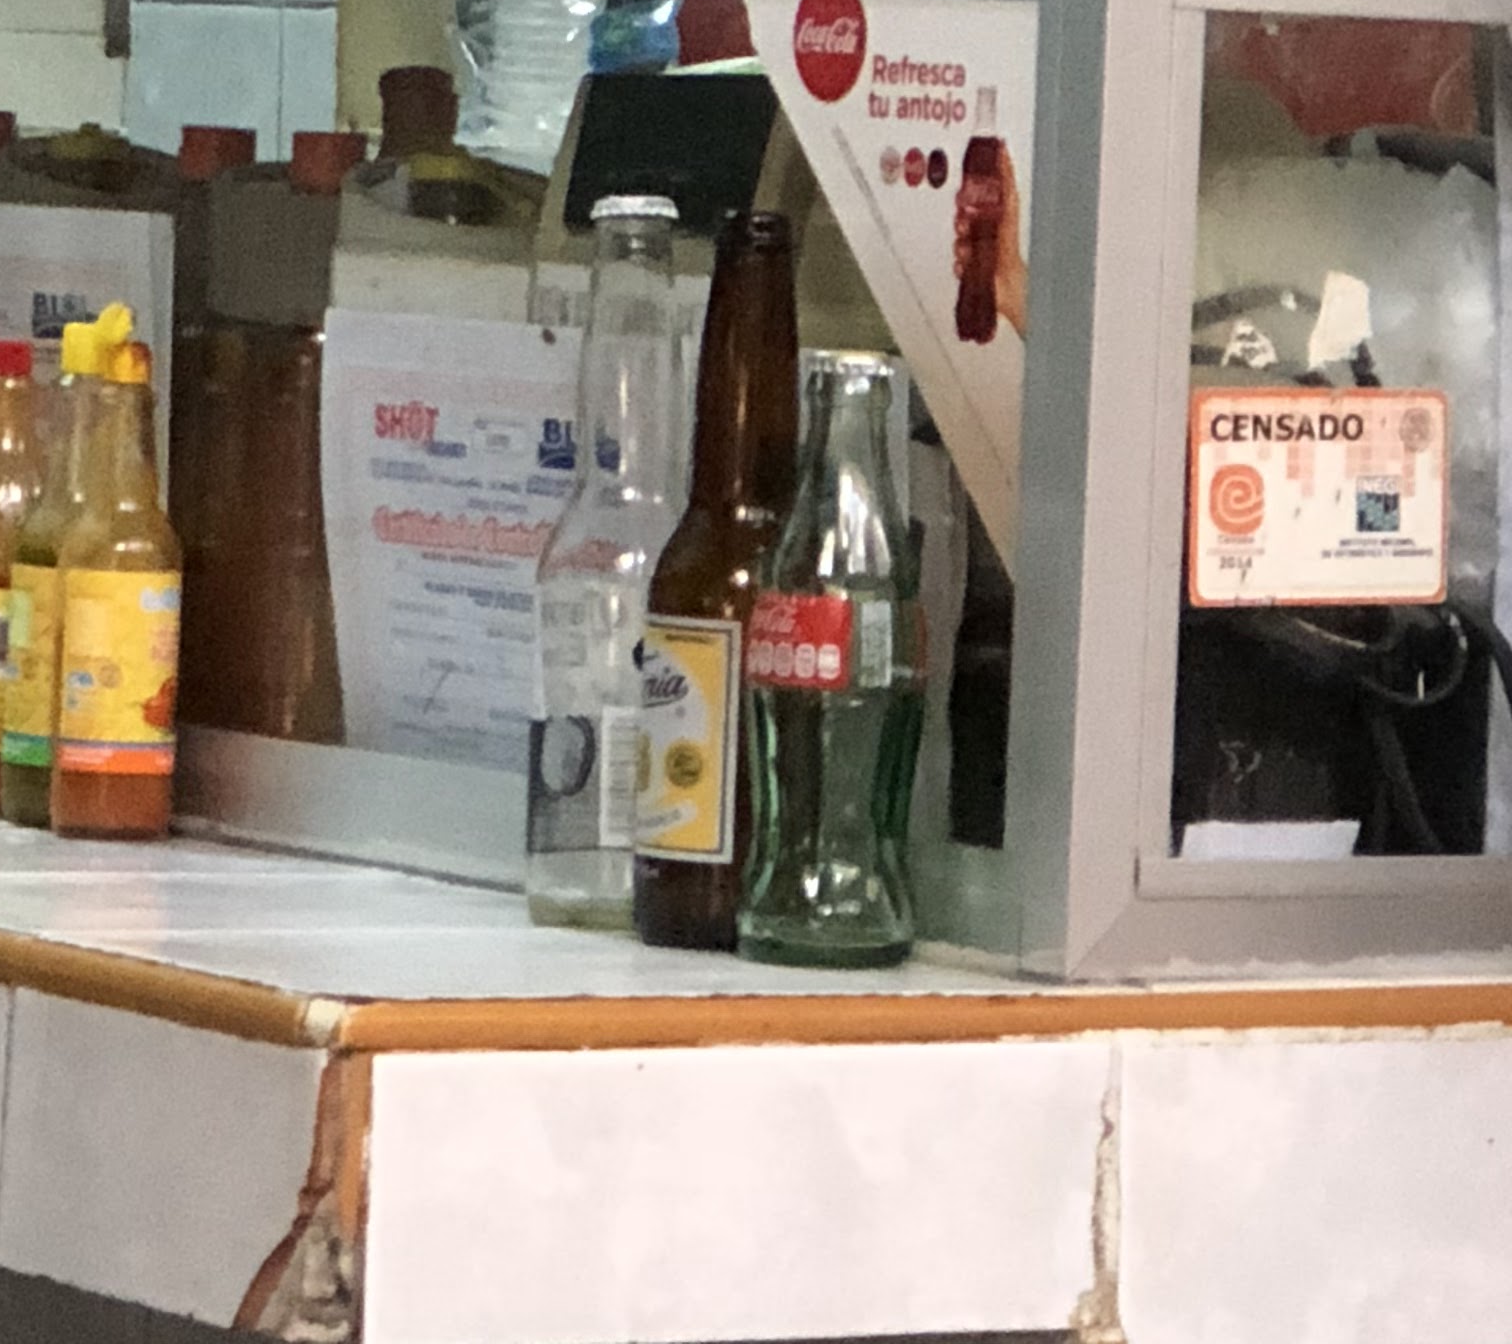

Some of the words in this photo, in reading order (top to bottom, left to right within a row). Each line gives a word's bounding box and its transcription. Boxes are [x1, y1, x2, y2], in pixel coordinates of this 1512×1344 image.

[872, 54, 967, 88] Refresca
[868, 92, 890, 120] tu
[896, 96, 968, 129] antojo
[1210, 413, 1364, 443] CENSADO
